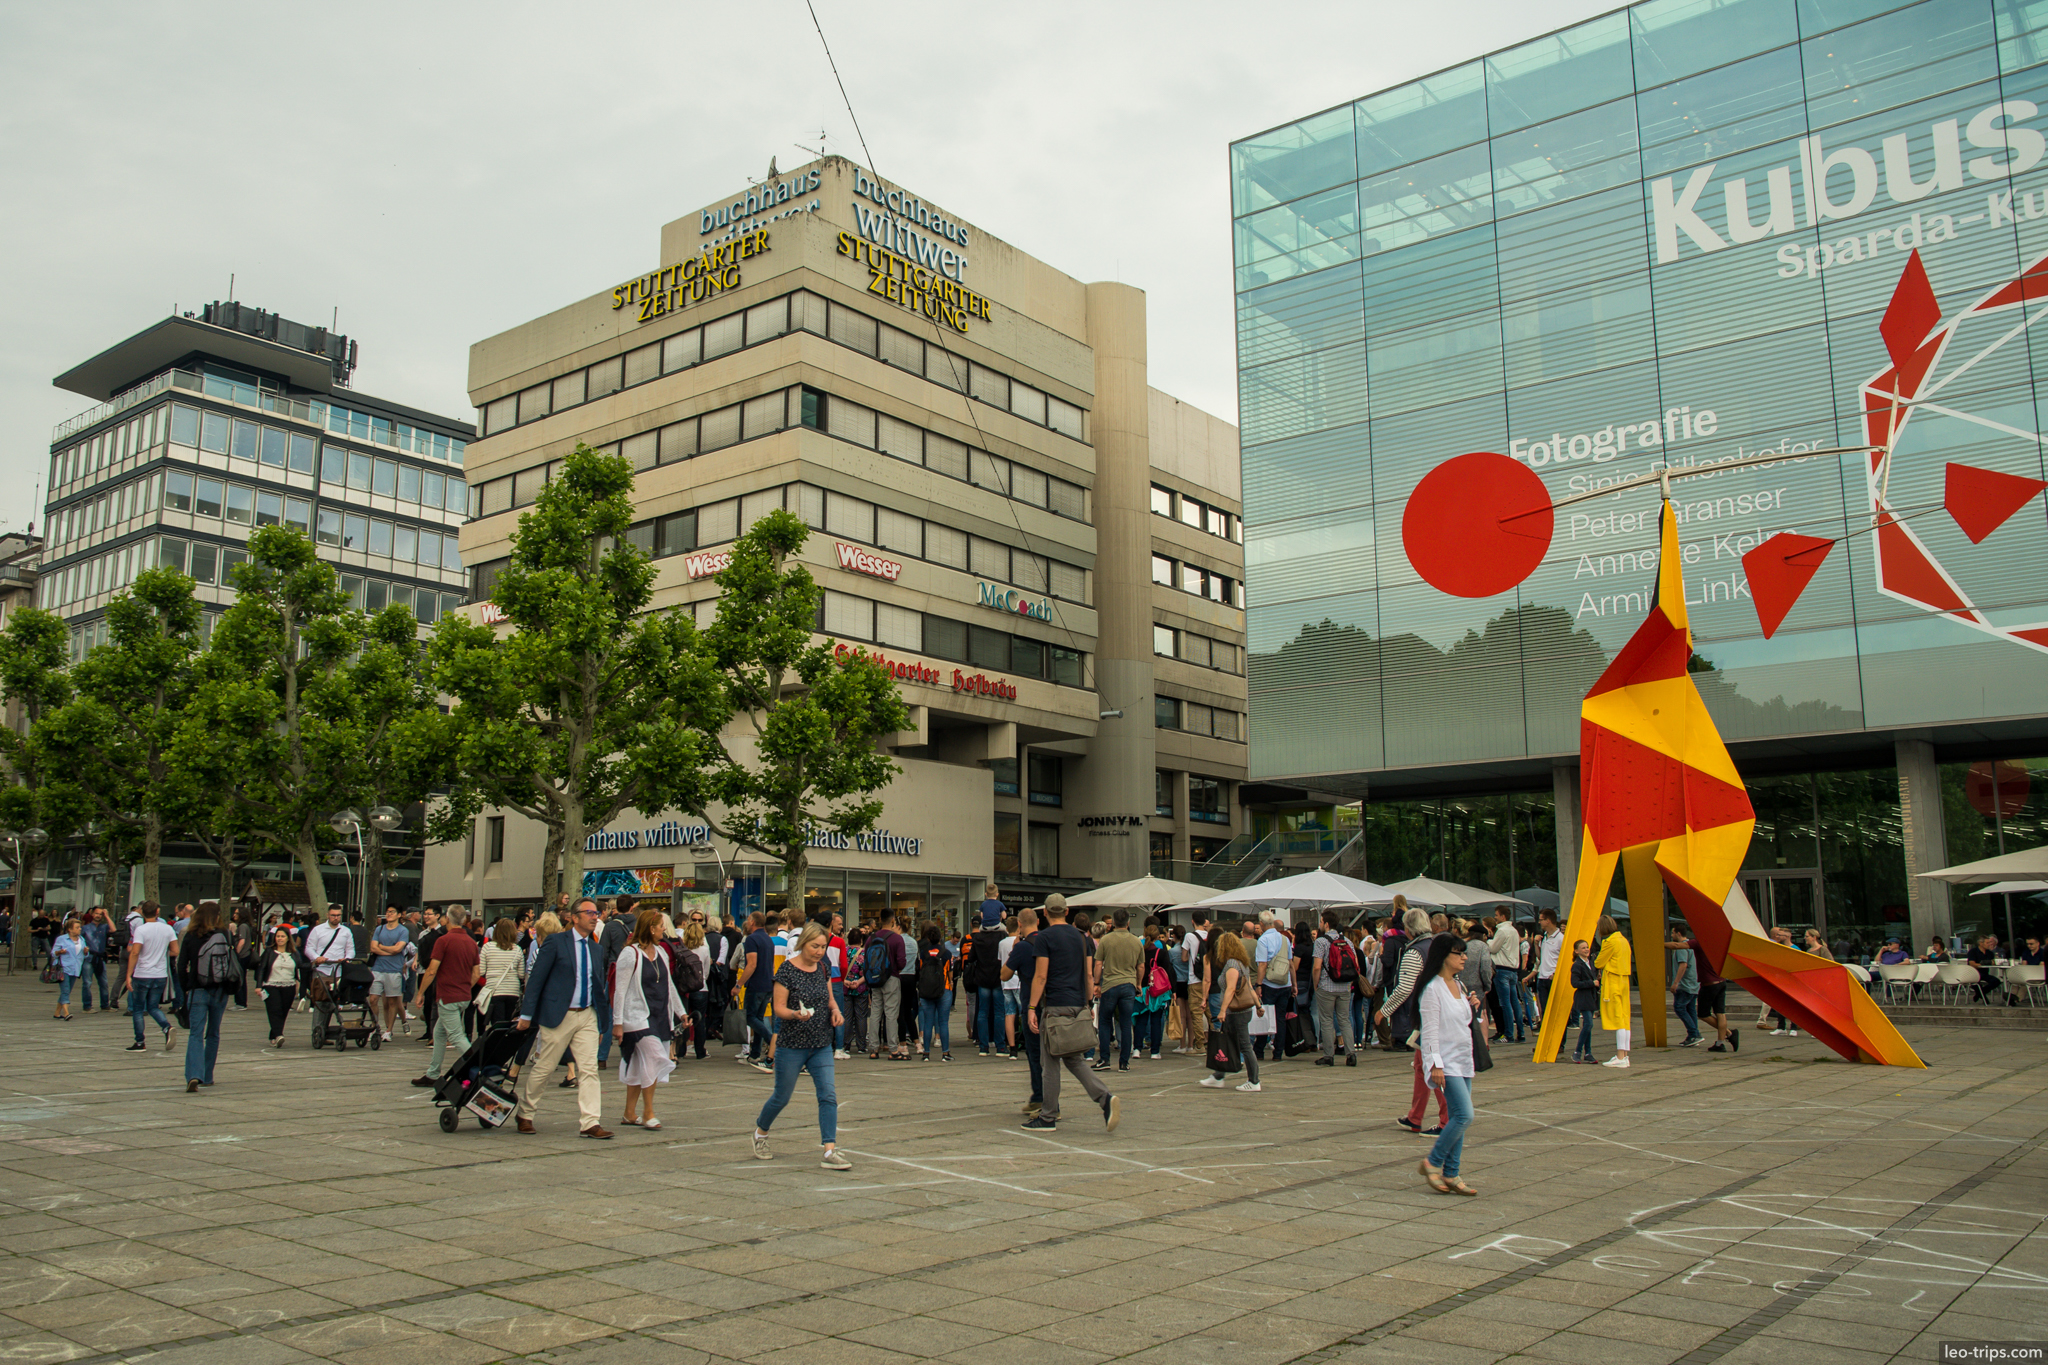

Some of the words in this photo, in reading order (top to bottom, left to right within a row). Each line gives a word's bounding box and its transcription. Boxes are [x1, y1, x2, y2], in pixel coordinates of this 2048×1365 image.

[699, 169, 821, 236] buchhaus
[853, 168, 969, 247] buchhaus
[1650, 99, 2046, 265] Kubus
[612, 229, 770, 312] STUTTGARTER
[852, 202, 968, 284] wittwer
[637, 265, 741, 323] ZEITUNG
[837, 231, 992, 323] STUTTGARTER
[867, 268, 969, 333] ZEITUNG
[1509, 406, 1718, 467] Fotografie
[1570, 510, 1649, 541] Peter
[1658, 487, 1787, 525] Granser
[834, 541, 903, 582] Wesser
[1574, 542, 1701, 580] Annee
[1576, 585, 1654, 619] Armi
[643, 821, 711, 847] wittwer
[856, 829, 924, 856] wittwer
[1077, 815, 1127, 828] JONNY
[1129, 816, 1143, 826] M.
[1112, 829, 1131, 837] Clubs
